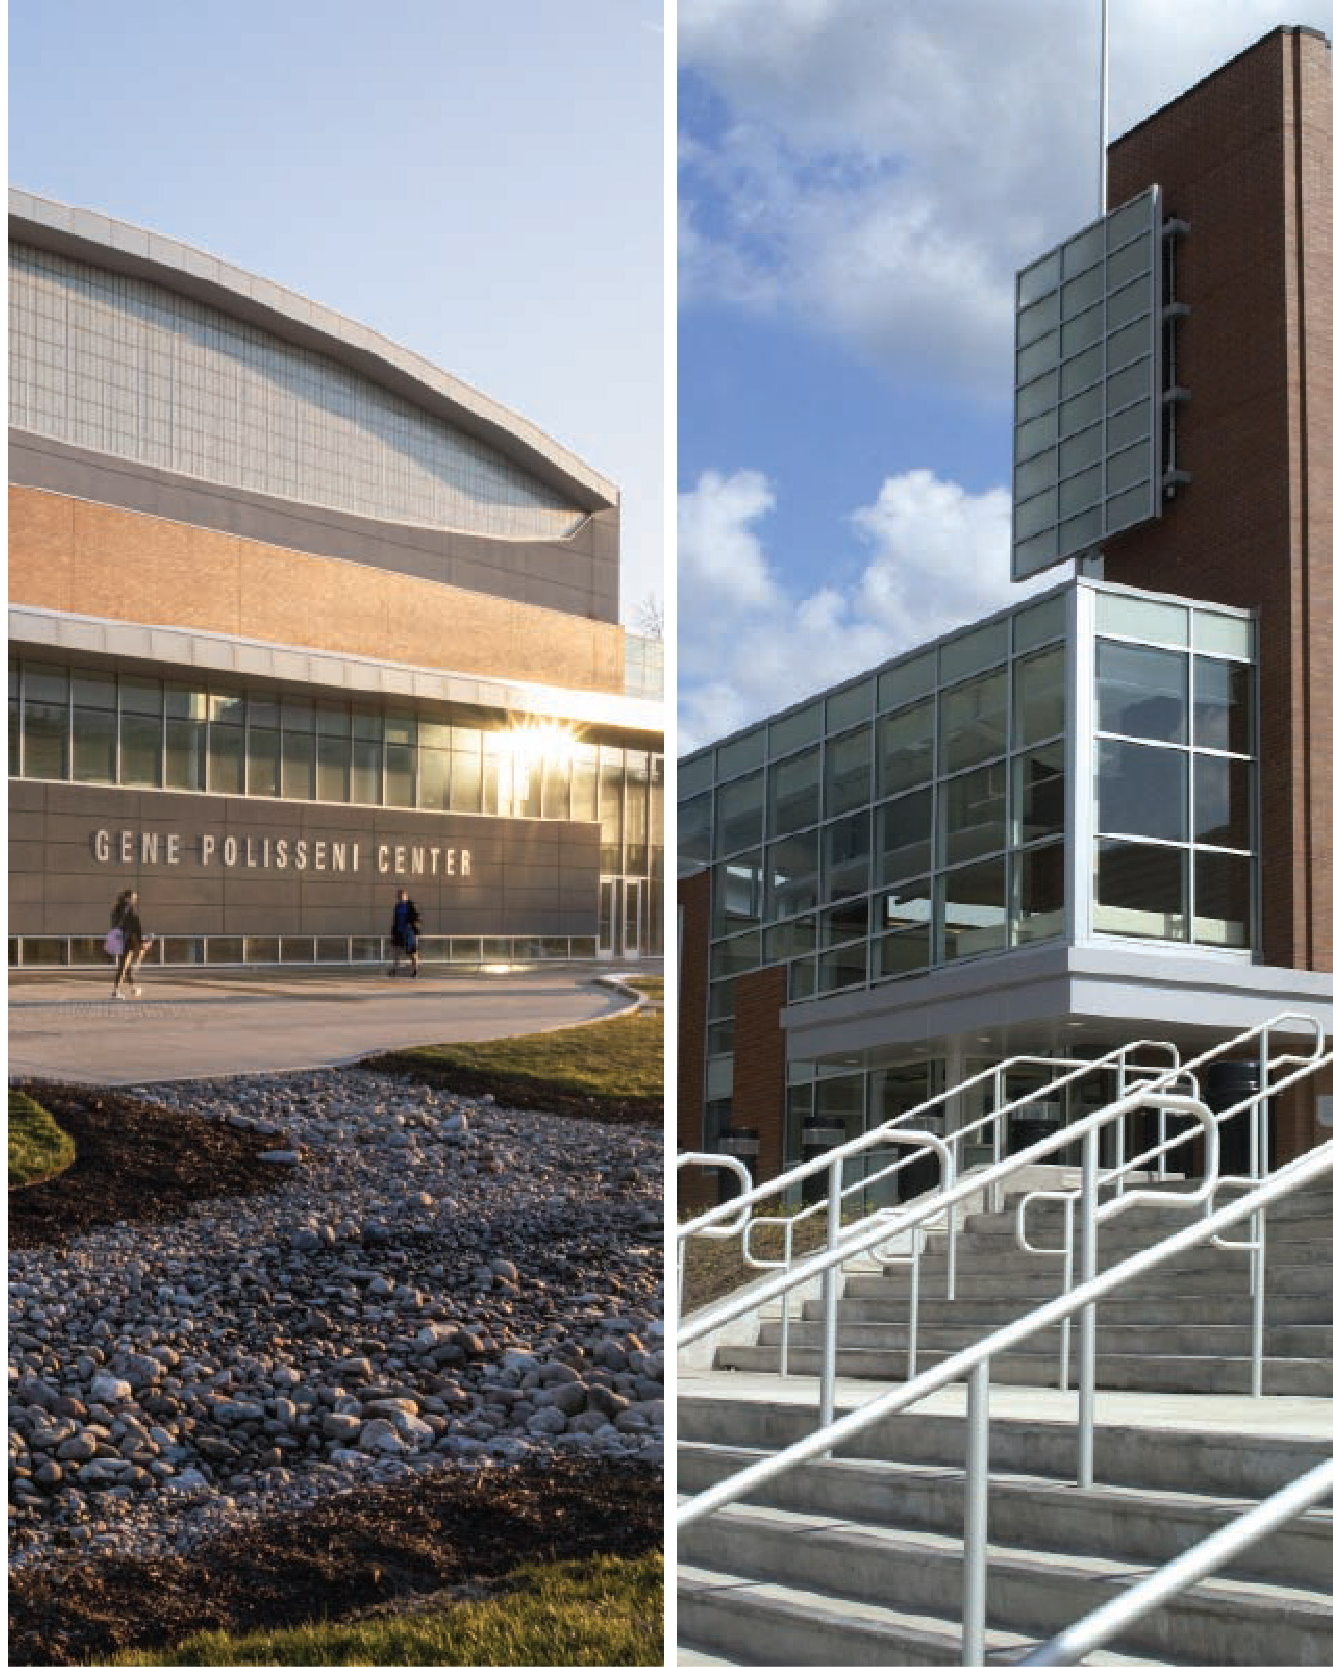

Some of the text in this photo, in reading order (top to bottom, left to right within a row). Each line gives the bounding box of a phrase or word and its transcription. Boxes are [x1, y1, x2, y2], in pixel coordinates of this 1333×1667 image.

[94, 830, 471, 876] GENE POLISSENI CENTER
